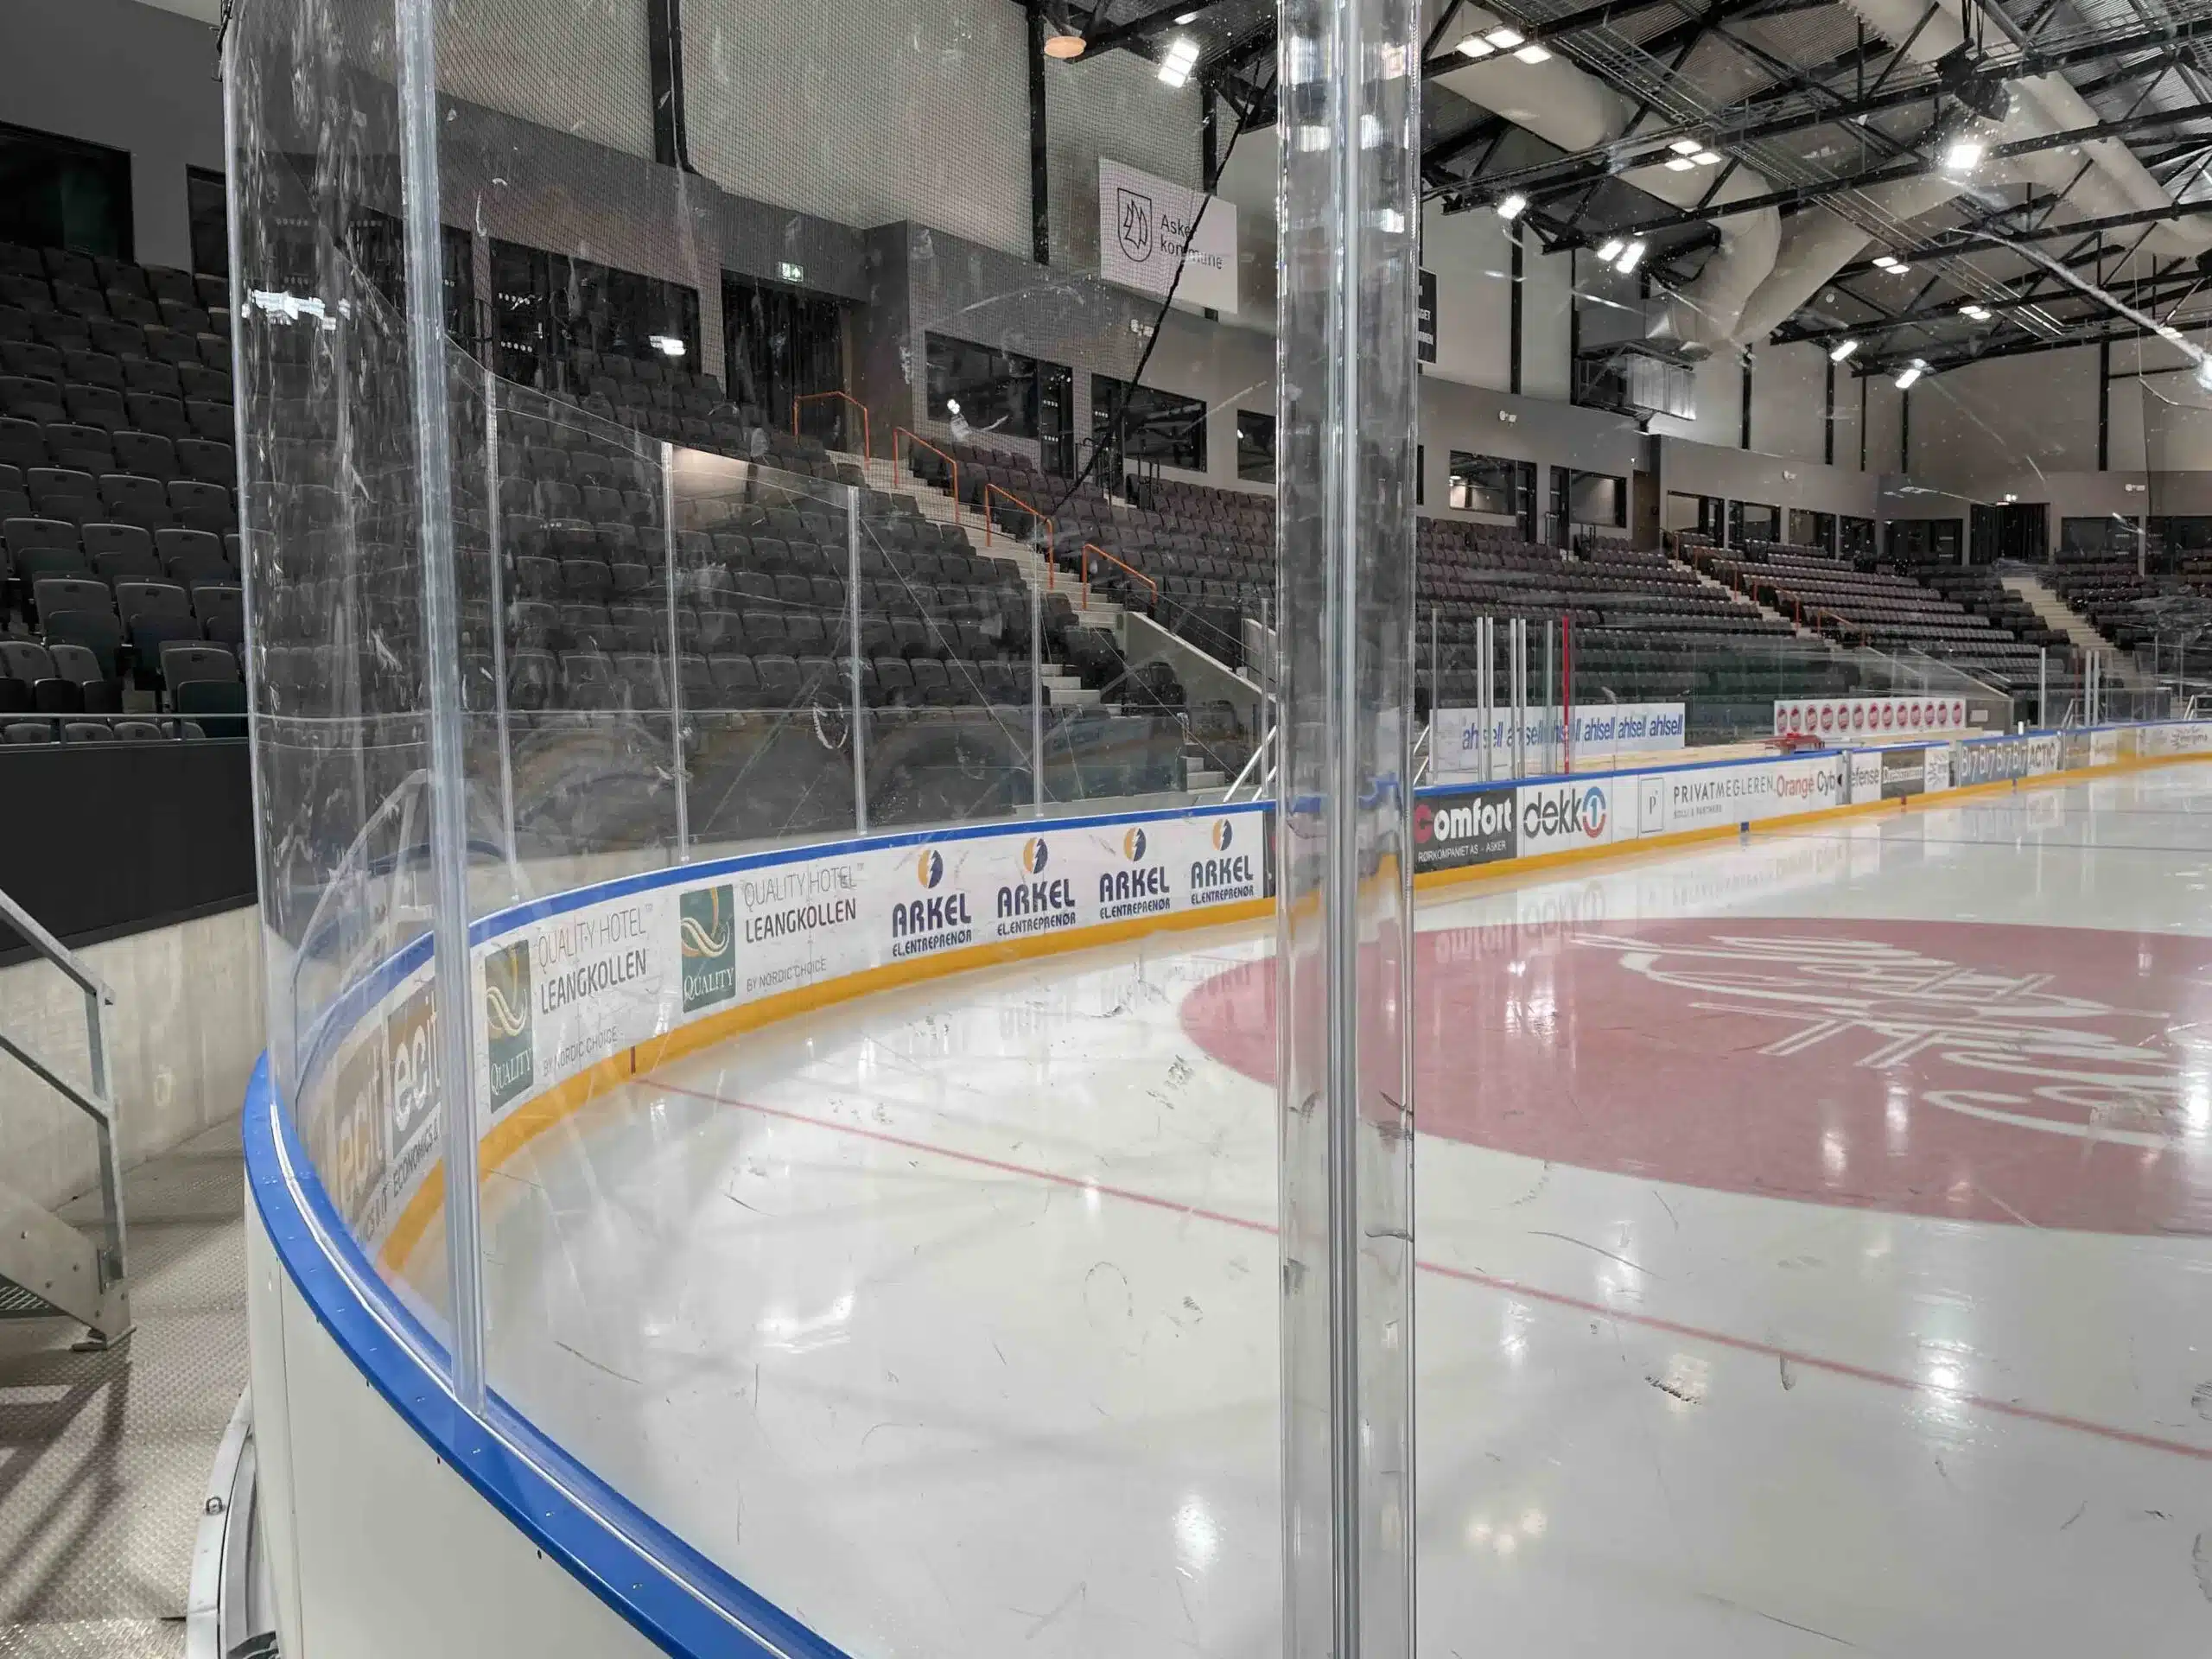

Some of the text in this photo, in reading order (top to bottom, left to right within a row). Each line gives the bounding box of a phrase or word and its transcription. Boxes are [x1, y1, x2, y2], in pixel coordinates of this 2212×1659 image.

[1160, 214, 1196, 239] Aske
[1649, 714, 1684, 737] ahlsell
[1777, 775, 1814, 799] Orange
[1485, 840, 1506, 851] ASKER
[744, 865, 857, 912] QUALITY HOTEL
[1099, 866, 1170, 903] ARKEL
[1191, 855, 1254, 889] ARKEL
[892, 893, 971, 938] ARKEL
[997, 878, 1076, 918] ARKEL
[537, 907, 646, 975] QUALITY HOTEL
[746, 899, 856, 944] LEANGKOLLEN
[540, 949, 647, 1015] LEANGKOLLEN
[683, 967, 734, 1001] QUALITY
[747, 958, 827, 993] BY NORDIC CHOICE
[394, 988, 442, 1133] ecit
[490, 1047, 533, 1096] QUALITY
[543, 1026, 618, 1077] BY NORDIC CHOICE
